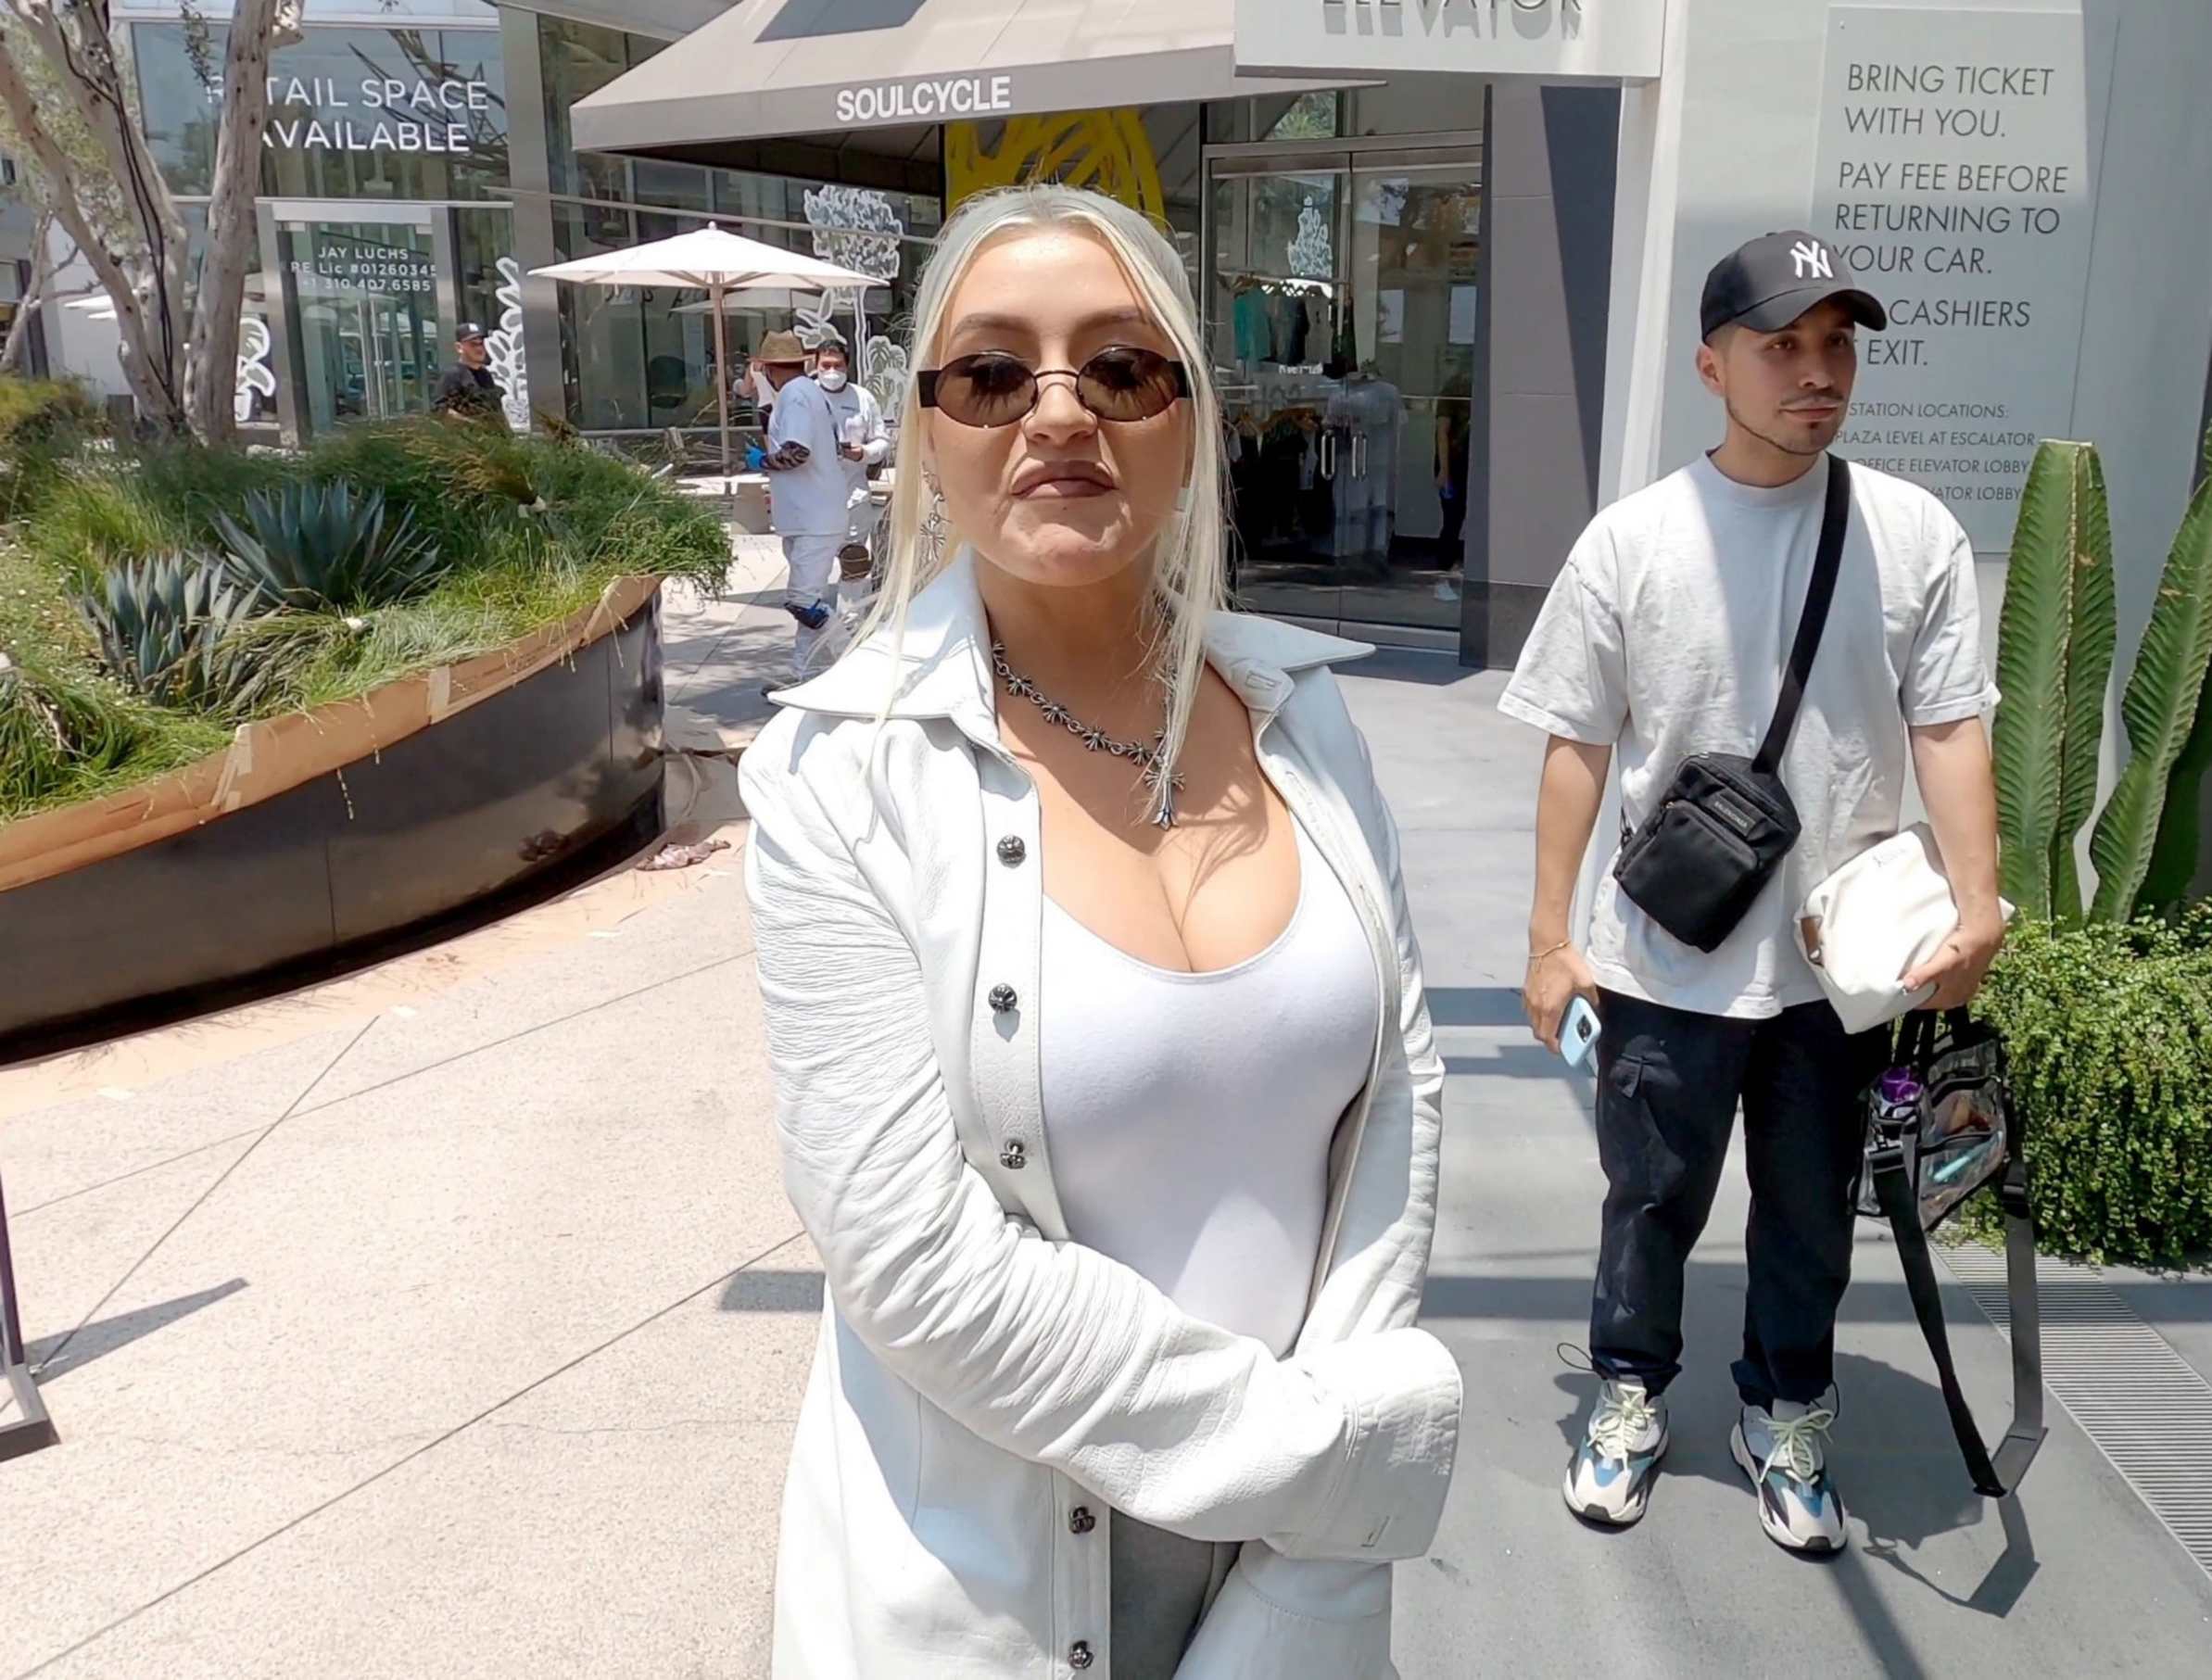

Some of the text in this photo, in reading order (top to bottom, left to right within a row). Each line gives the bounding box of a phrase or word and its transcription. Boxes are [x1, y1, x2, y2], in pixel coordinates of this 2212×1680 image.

[206, 76, 488, 110] RTAIL SPACE
[1848, 63, 2054, 96] BRING TICKET
[836, 75, 1012, 121] SOULCYCLE
[262, 120, 471, 152] VAILABLE
[1844, 107, 2005, 137] WITH YOU.
[1839, 161, 2069, 194] PAY FEE BEFORE
[1835, 203, 2060, 234] RETURNING TO
[318, 246, 409, 260] JAY LUCHS
[1924, 246, 1992, 274] CAR.
[319, 262, 344, 274] Lic
[1889, 299, 2031, 327] CASHIERS
[1867, 339, 1928, 366] EXIT.
[1849, 402, 1914, 417] STATION
[1835, 430, 2035, 447] PLAZA LEVEL AT ESCALATOR
[1910, 459, 1979, 474] ELEVATOR
[1984, 460, 2030, 474] LOBBY
[1977, 486, 2022, 501] LOBBY
